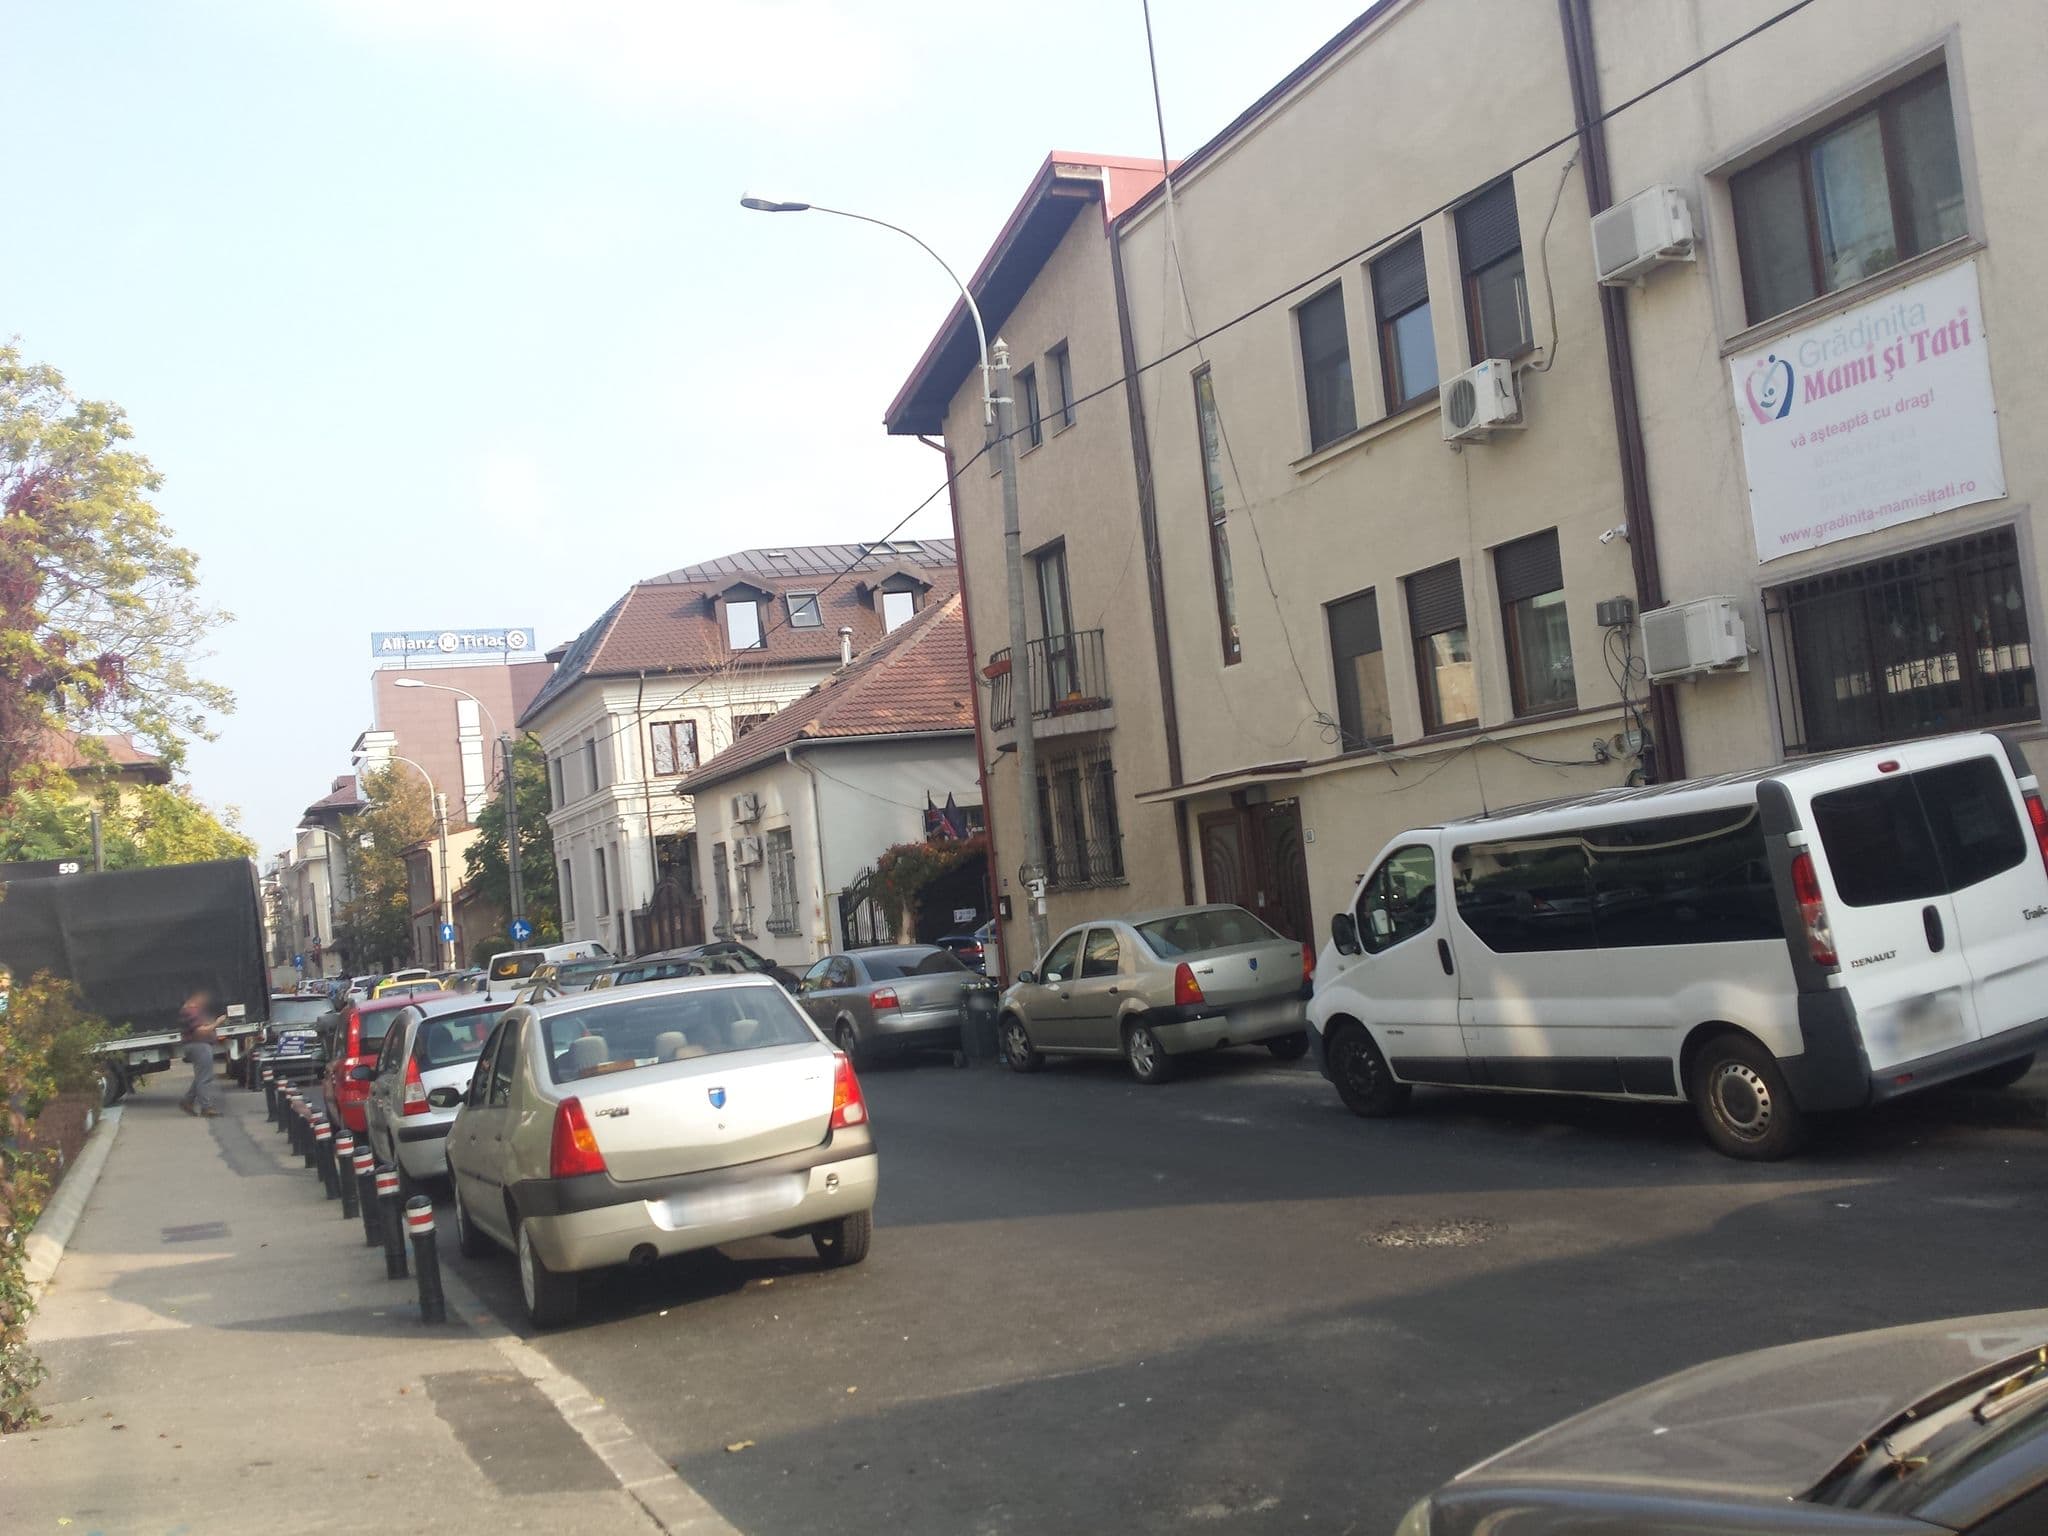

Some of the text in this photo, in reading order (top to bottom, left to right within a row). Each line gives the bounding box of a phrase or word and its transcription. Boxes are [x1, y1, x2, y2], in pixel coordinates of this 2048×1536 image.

[1803, 341, 1877, 404] Mami
[1910, 306, 1971, 363] Tati
[1873, 405, 1891, 421] cu
[1895, 386, 1935, 413] drag!
[1779, 479, 1976, 545] www.gradinita-mamisitati.ro
[382, 636, 436, 651] Allianz
[58, 862, 79, 874] 59
[1850, 949, 1896, 968] RENAULT
